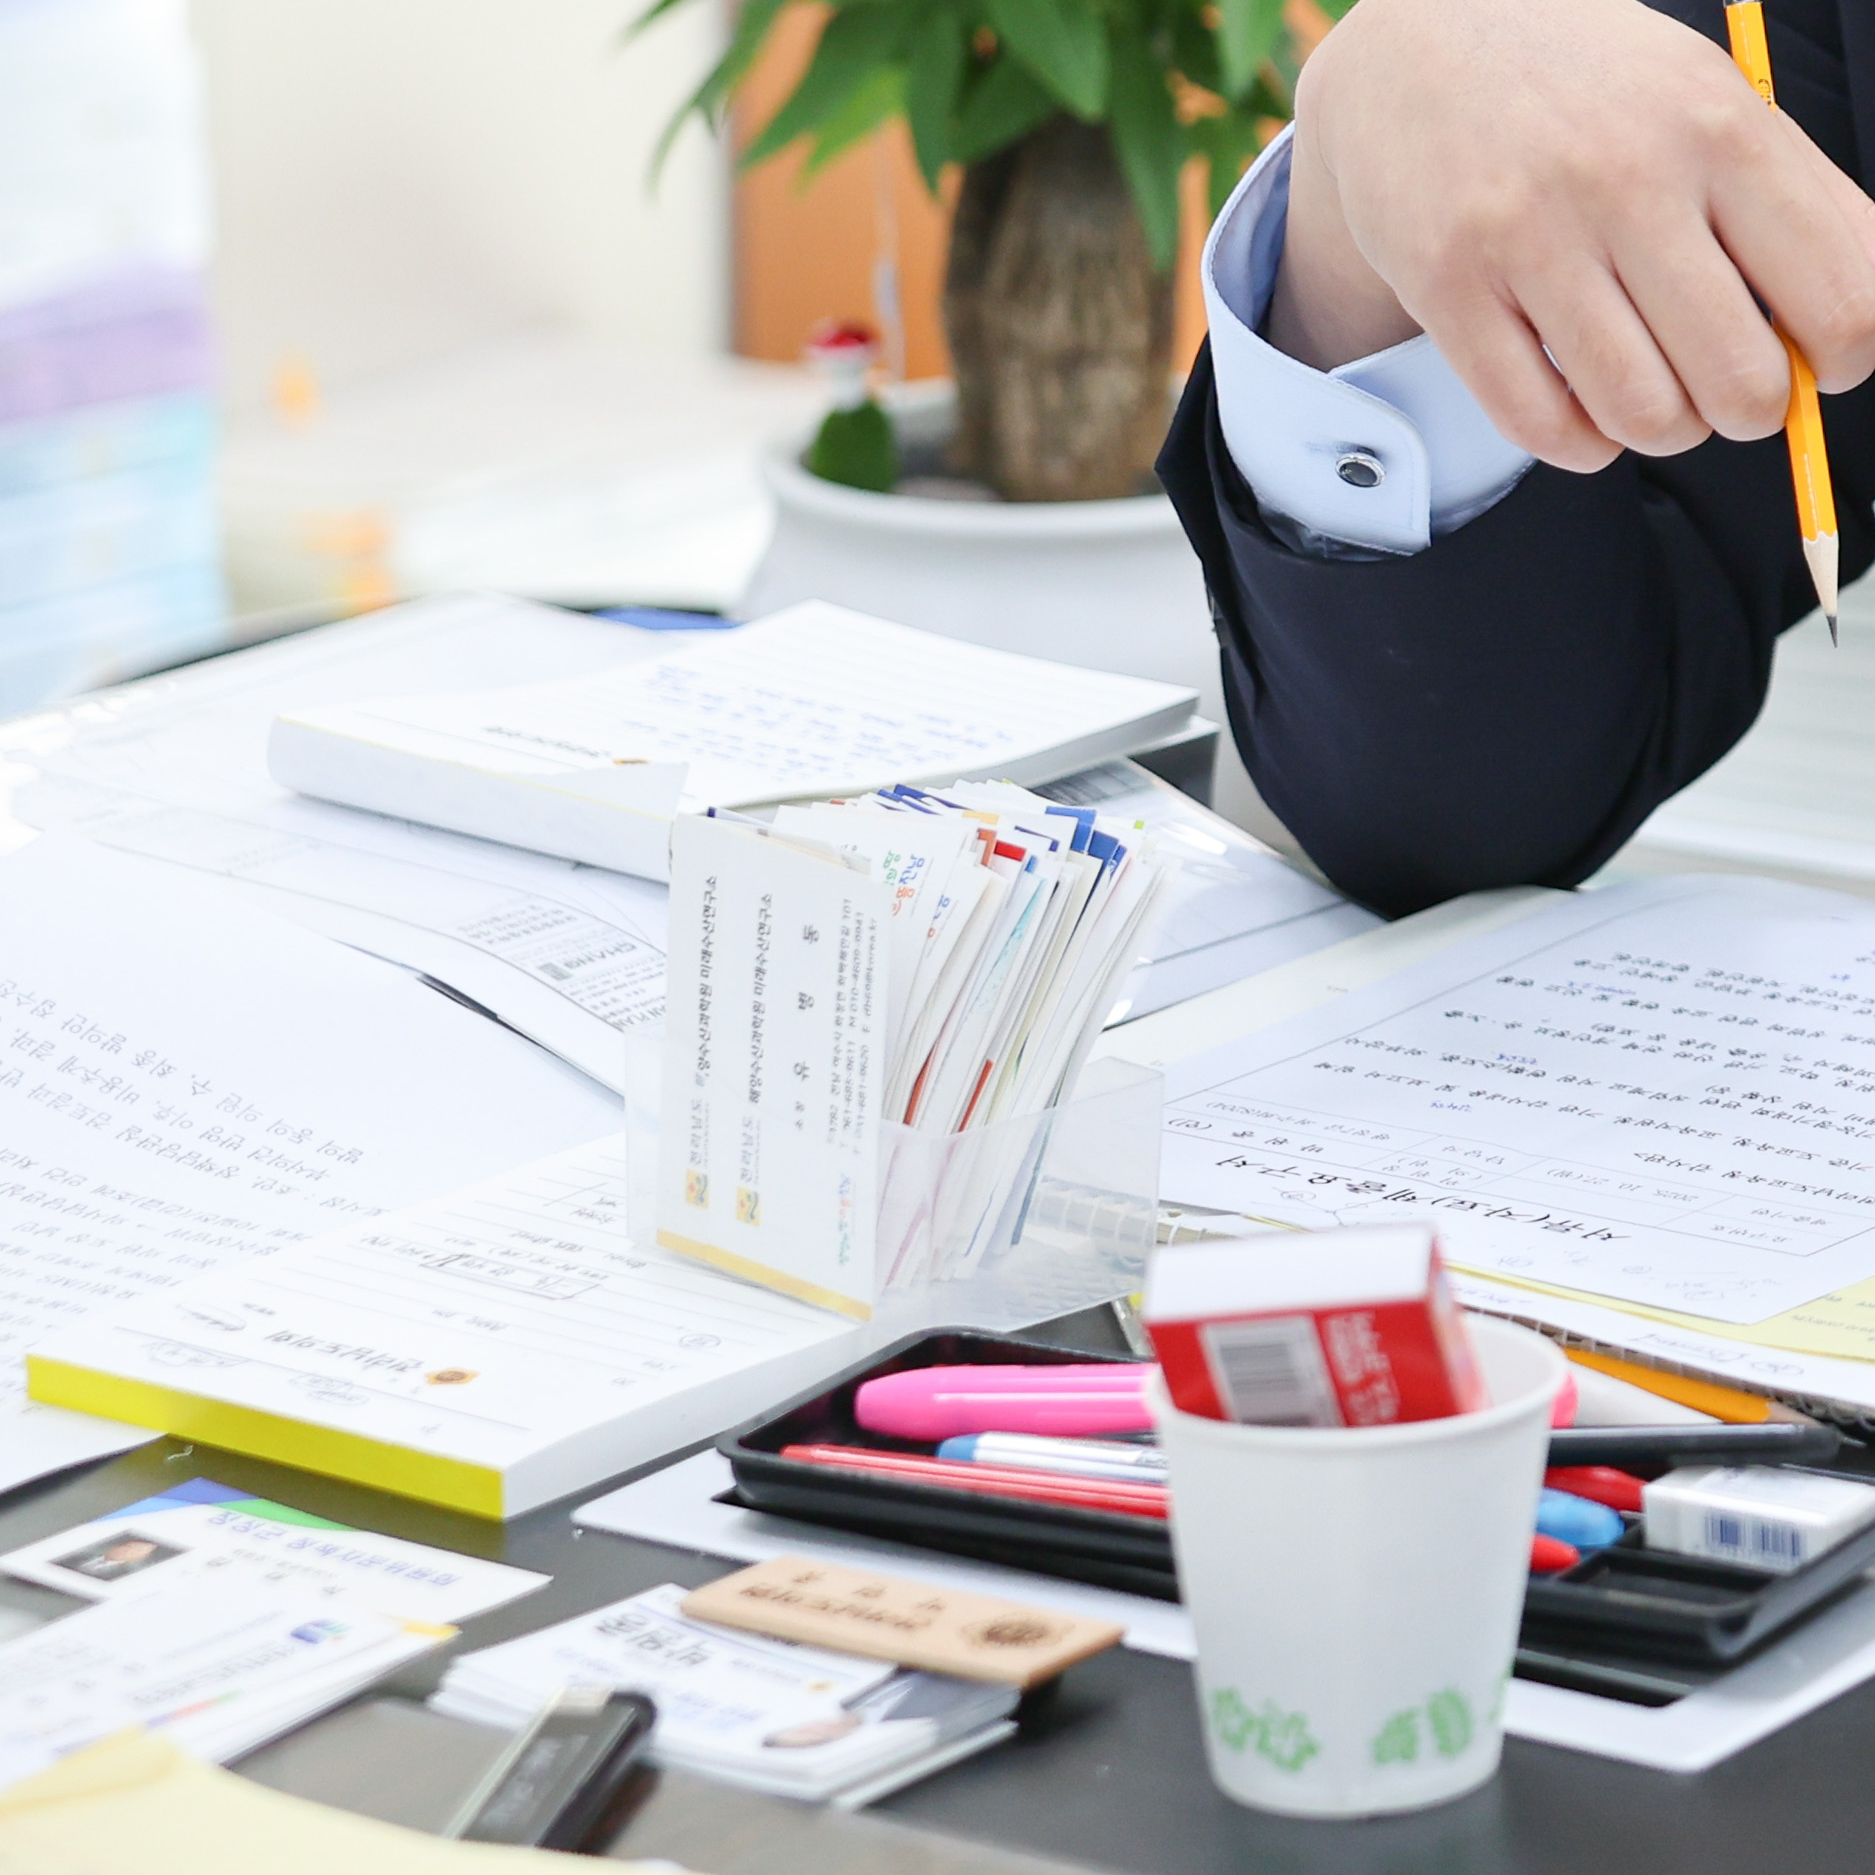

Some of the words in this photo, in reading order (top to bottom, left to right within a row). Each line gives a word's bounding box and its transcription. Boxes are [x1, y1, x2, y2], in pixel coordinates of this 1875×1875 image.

[700, 876, 717, 979] 미래수산연구소
[753, 894, 772, 996] 미래수산연구소
[748, 1000, 765, 1104] 해양수산과학원
[1215, 1155, 1628, 1241] 서류(자료)제출요구서
[263, 1330, 424, 1373] 전라남도의회
